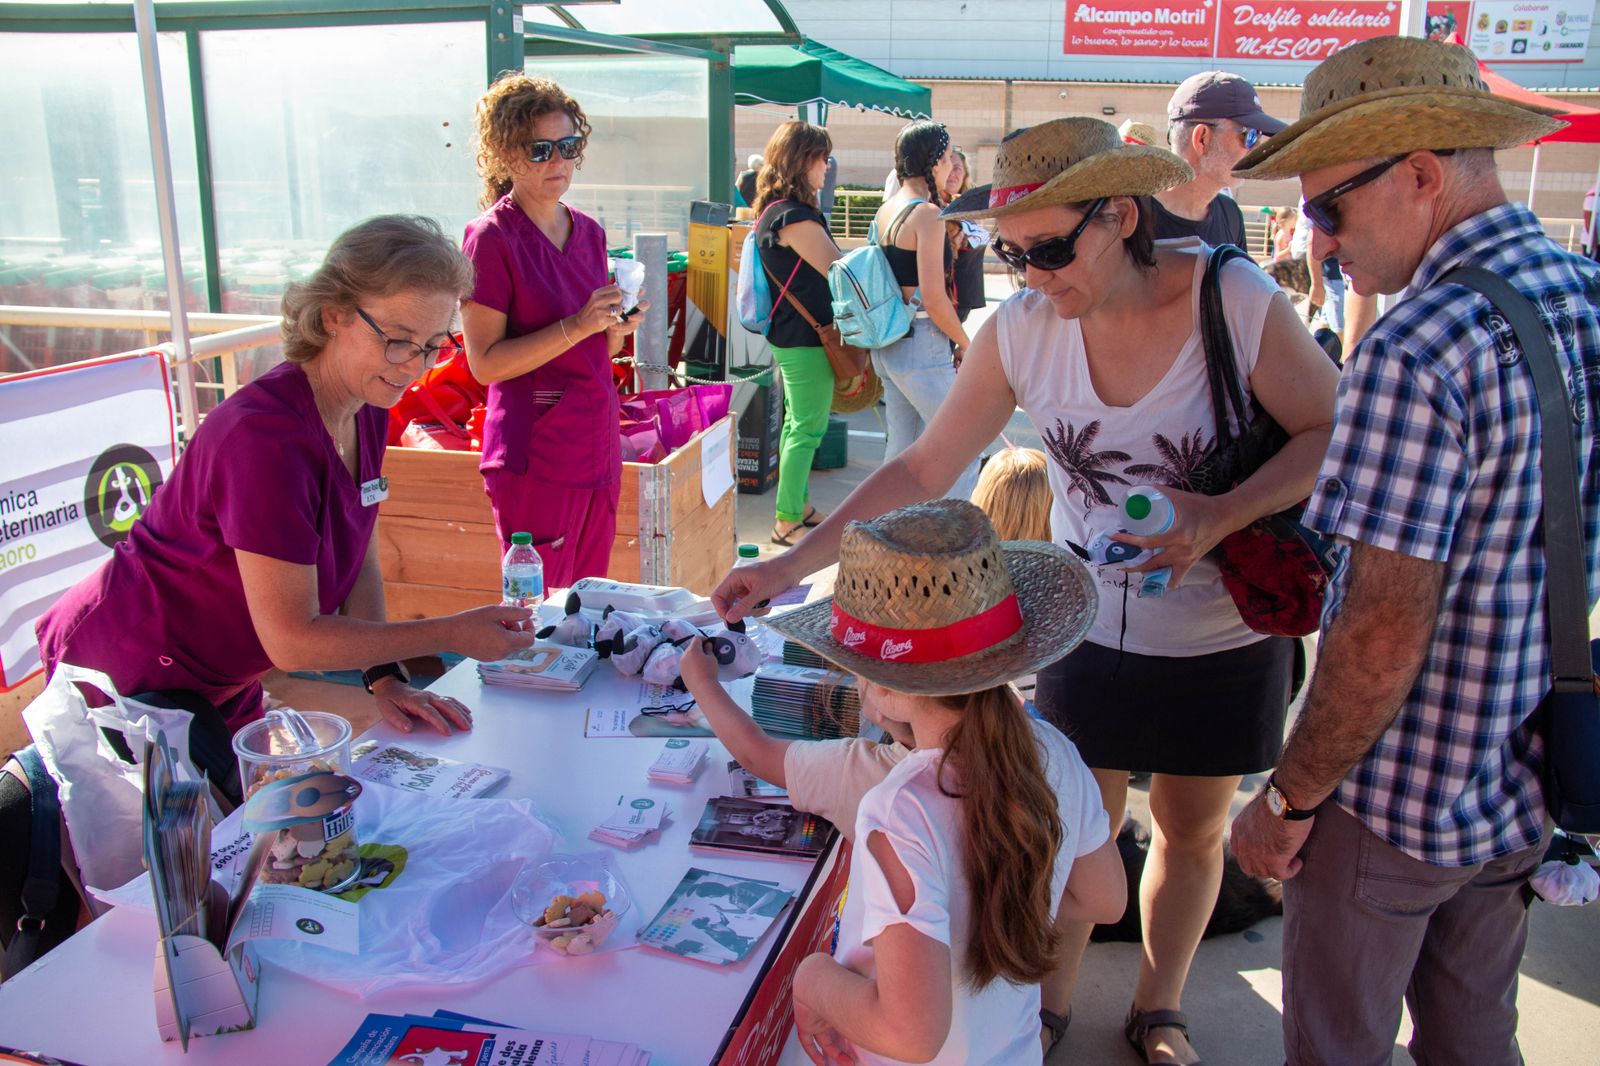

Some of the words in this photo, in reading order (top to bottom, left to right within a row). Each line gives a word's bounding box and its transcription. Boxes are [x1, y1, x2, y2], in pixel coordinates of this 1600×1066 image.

[1074, 4, 1153, 26] Alcampo
[1154, 8, 1206, 24] Motril
[1233, 5, 1301, 32] Desfile
[1307, 8, 1391, 27] solidario
[1072, 36, 1082, 46] lo
[1084, 36, 1118, 47] bueno,
[1121, 36, 1132, 46] lo
[1133, 39, 1158, 47] sano
[1159, 40, 1168, 48] y
[1168, 38, 1180, 47] lo
[1181, 38, 1209, 48] local
